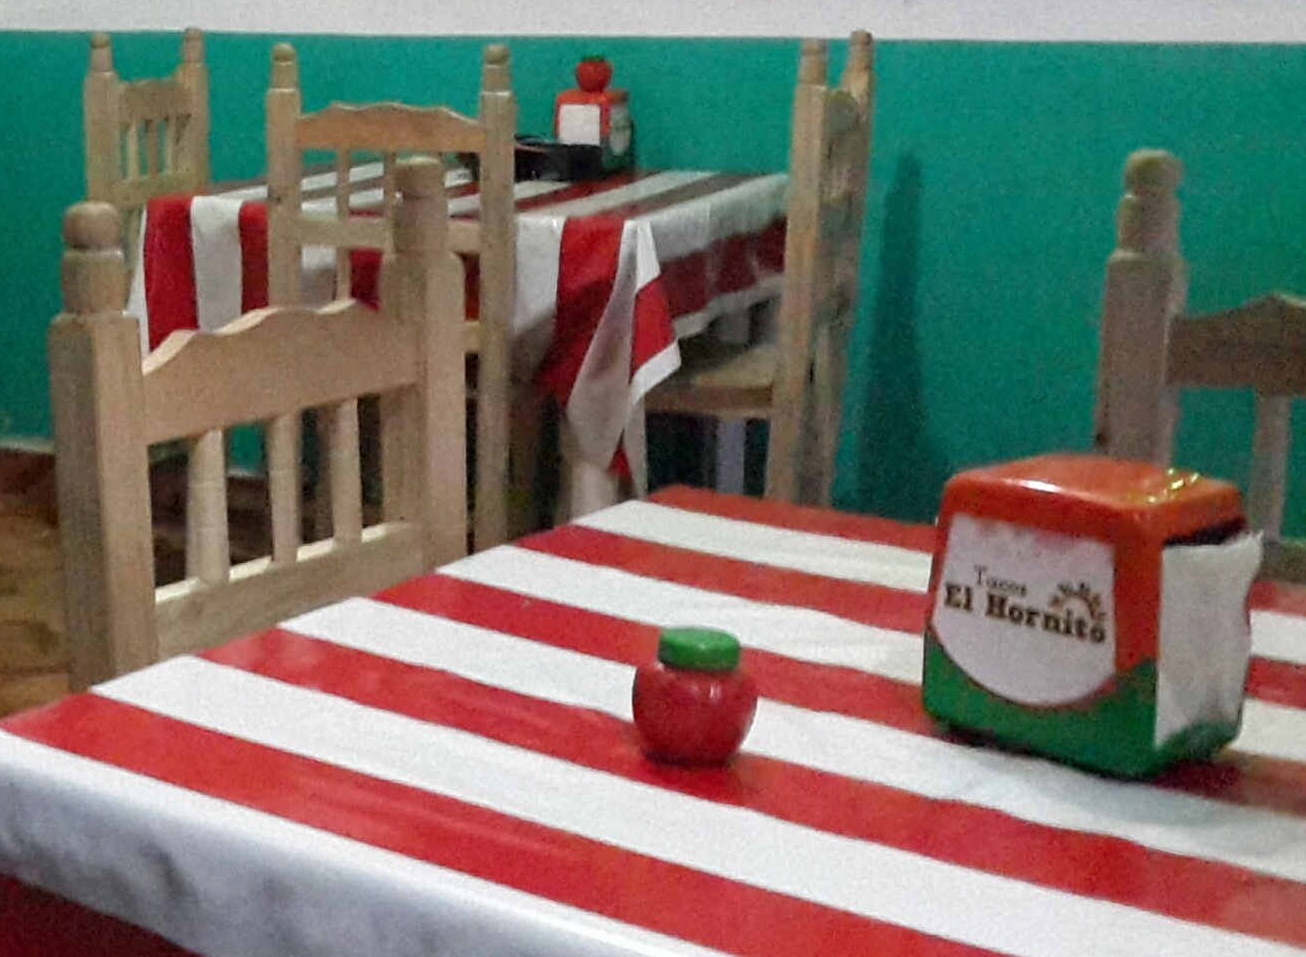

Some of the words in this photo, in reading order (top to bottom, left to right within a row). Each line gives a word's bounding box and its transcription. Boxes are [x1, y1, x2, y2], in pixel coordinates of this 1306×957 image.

[974, 565, 1027, 598] Tacos
[944, 581, 973, 612] El
[985, 592, 1107, 643] Hornito
